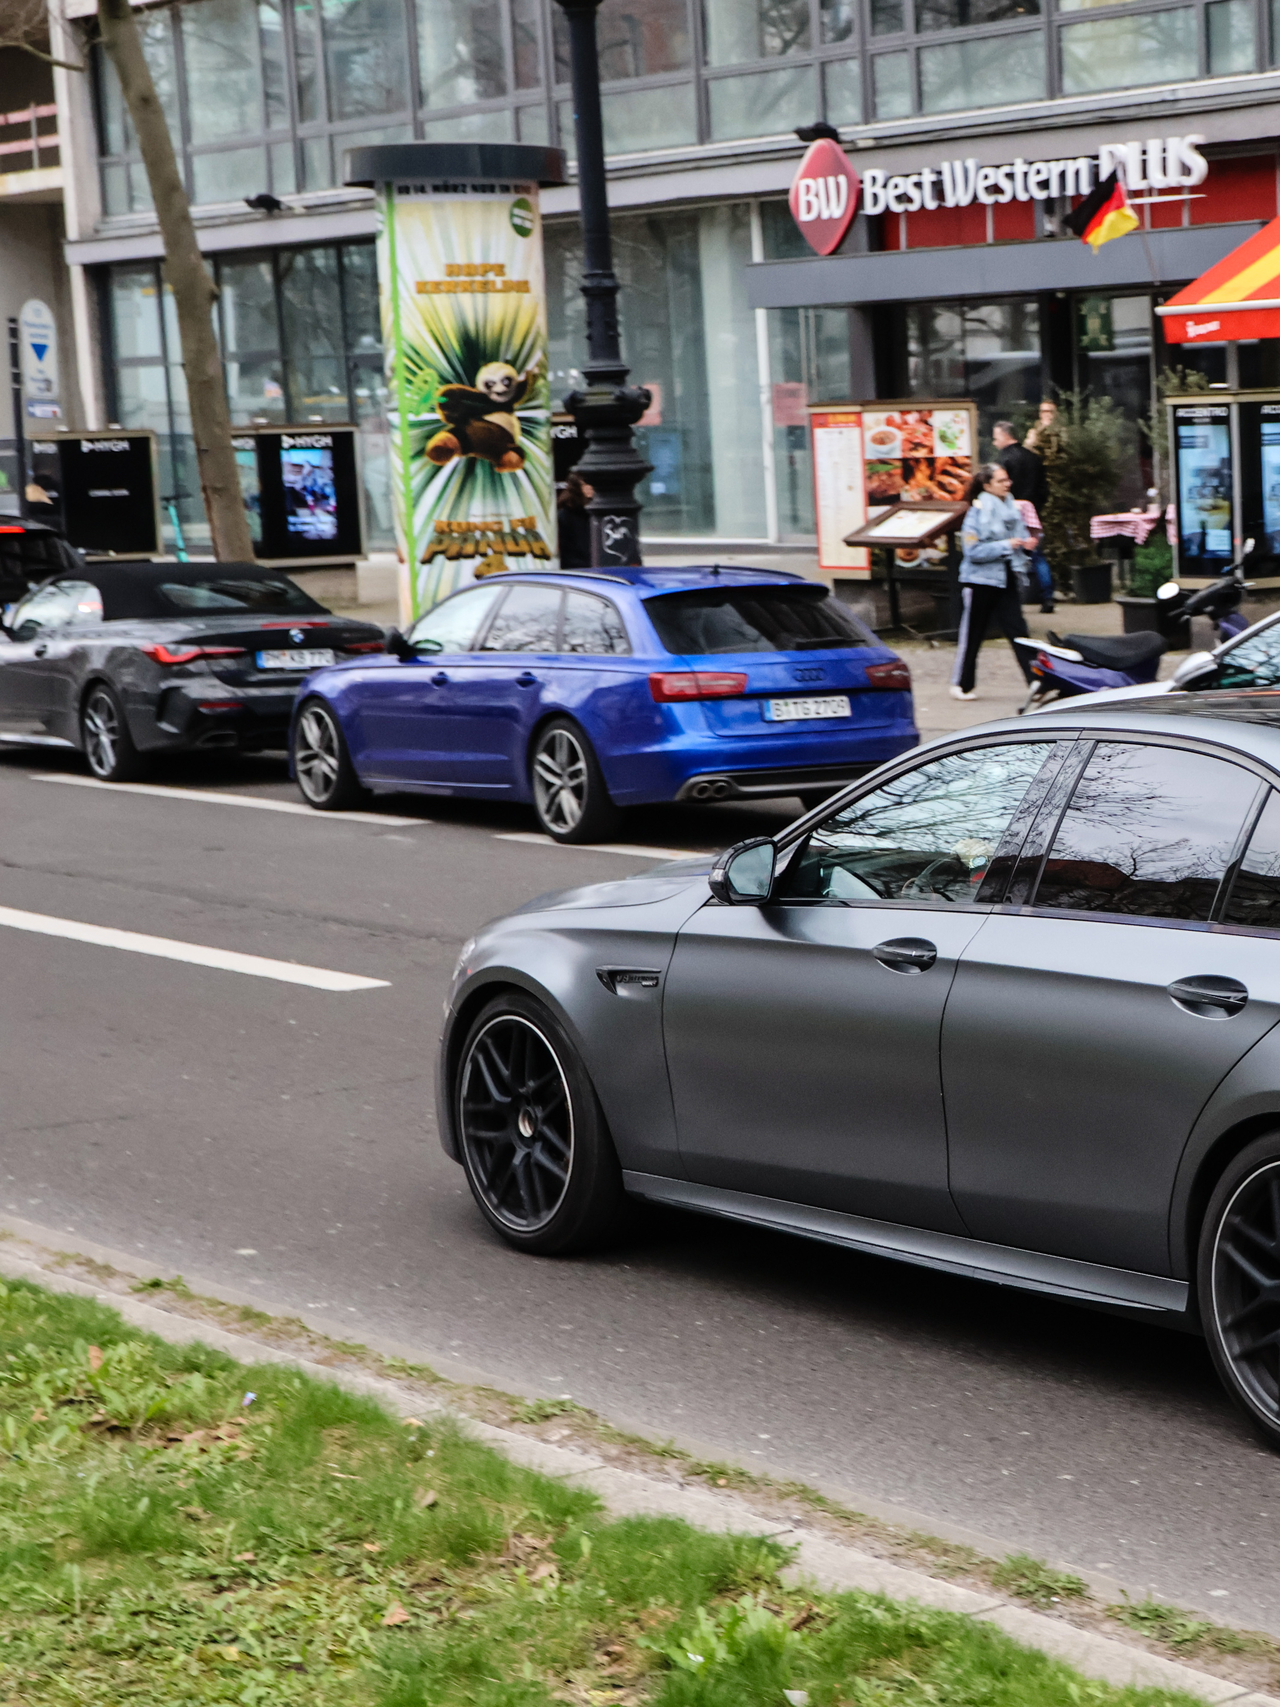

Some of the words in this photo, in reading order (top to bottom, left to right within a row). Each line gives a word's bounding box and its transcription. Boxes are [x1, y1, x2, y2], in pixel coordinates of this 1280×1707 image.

[800, 174, 848, 222] BW
[862, 168, 938, 215] Best
[941, 157, 1094, 208] Western
[1099, 134, 1208, 191] PLUS
[419, 529, 551, 564] PANDA
